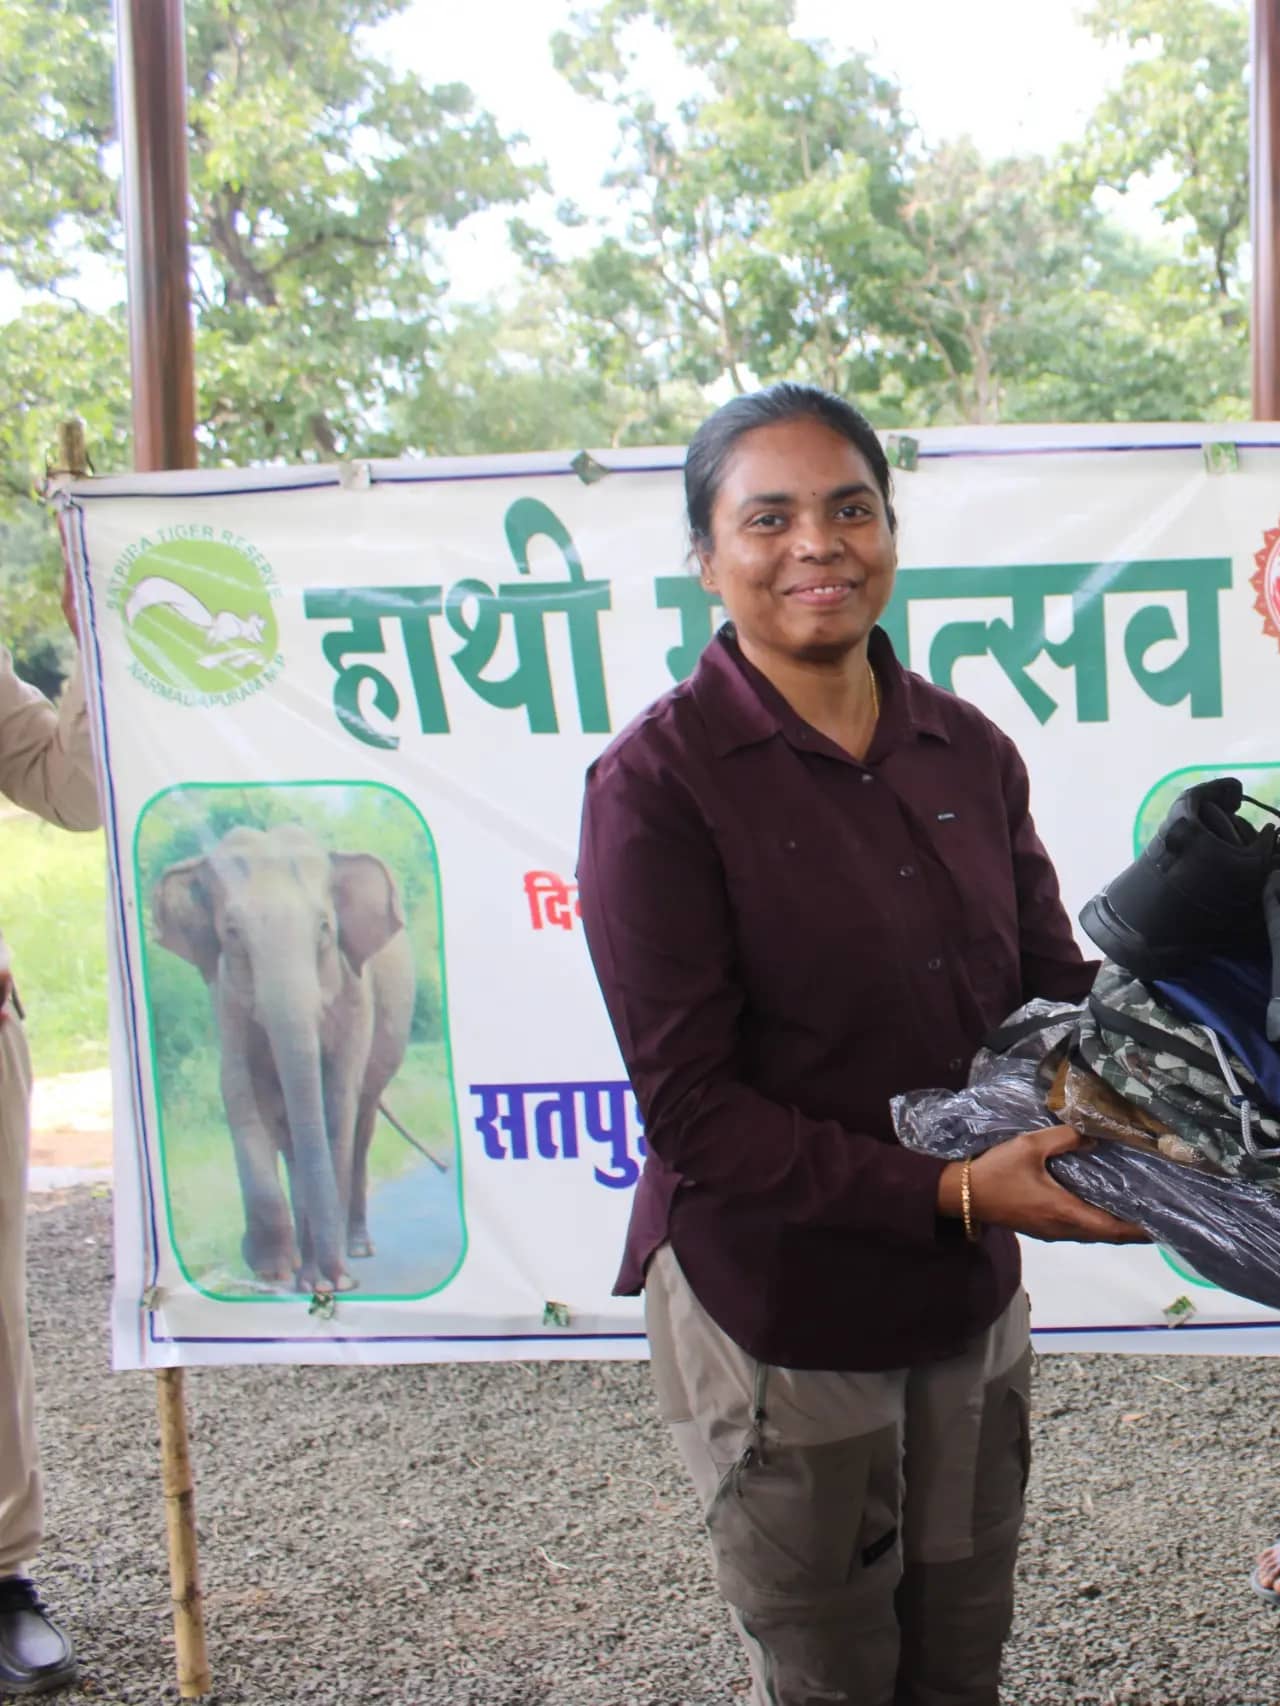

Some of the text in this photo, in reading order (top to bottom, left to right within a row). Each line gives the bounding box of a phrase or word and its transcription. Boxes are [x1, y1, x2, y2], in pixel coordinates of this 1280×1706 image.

[106, 523, 283, 609] SATPURA TIGER RESERVE
[303, 497, 612, 750] हाथी
[469, 1081, 647, 1190] सतपु
